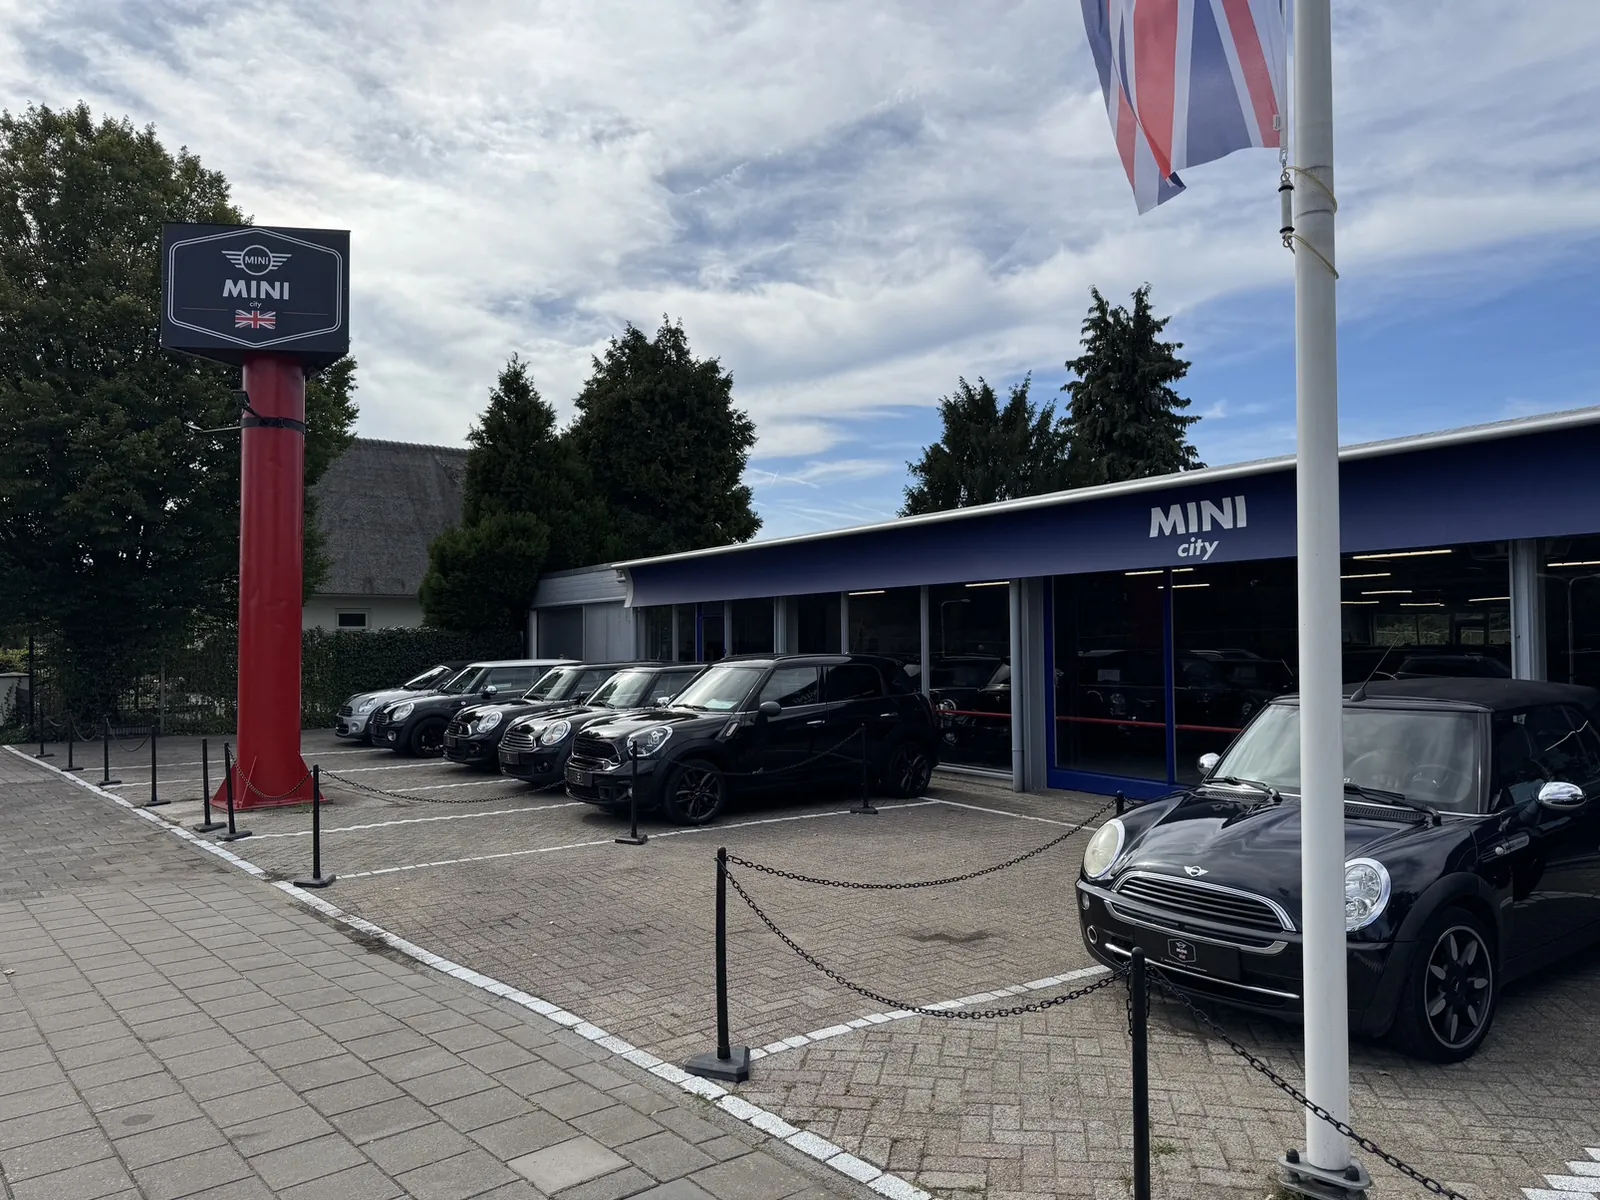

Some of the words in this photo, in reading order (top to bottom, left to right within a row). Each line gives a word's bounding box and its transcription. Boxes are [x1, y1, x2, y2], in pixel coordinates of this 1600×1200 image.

[244, 255, 269, 265] MINI
[222, 279, 290, 300] MINI
[249, 301, 262, 309] city
[1149, 495, 1247, 538] MINI
[1177, 537, 1220, 561] city
